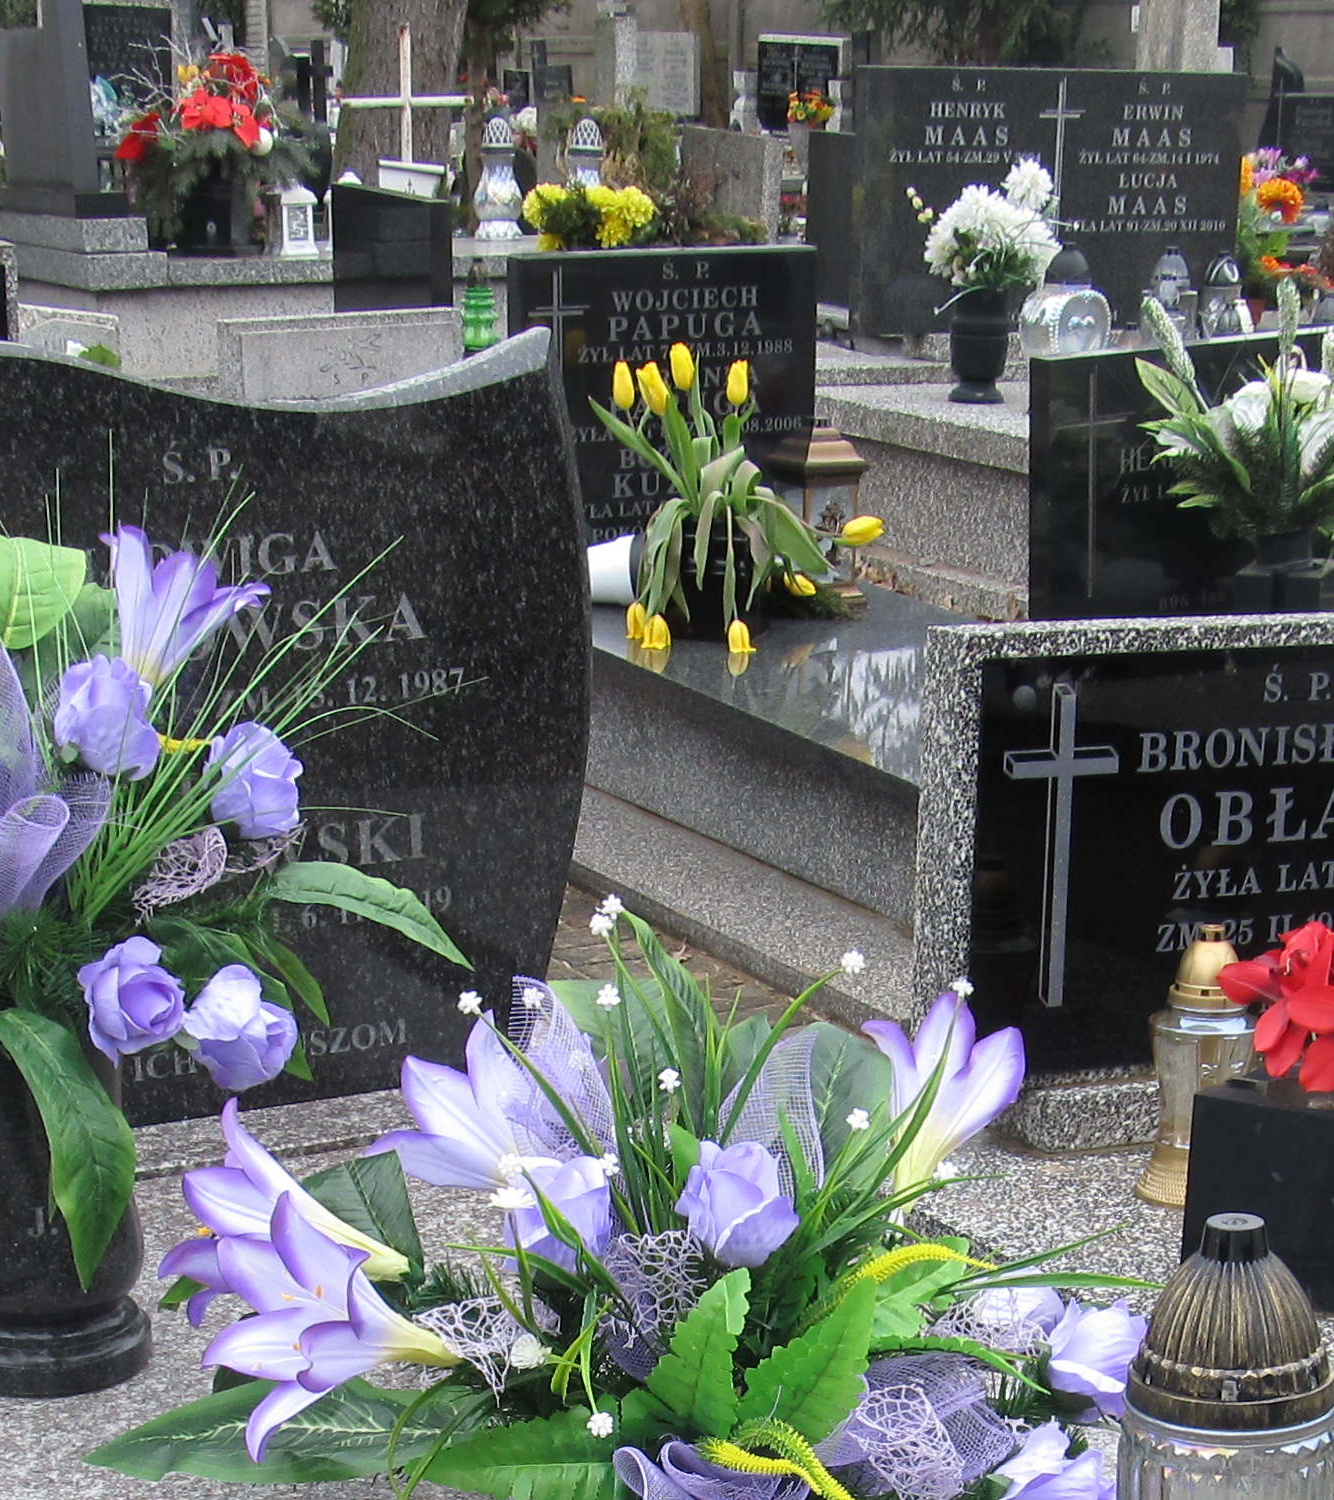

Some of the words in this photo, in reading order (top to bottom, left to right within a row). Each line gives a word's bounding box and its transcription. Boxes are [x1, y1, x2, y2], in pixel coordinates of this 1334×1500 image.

[929, 101, 1007, 119] HENRYK
[1122, 103, 1186, 121] ERWIN
[923, 124, 1010, 147] MAAS
[1111, 127, 1193, 148] MAAS
[888, 148, 916, 164] ŻYŁ
[917, 150, 944, 164] LAT
[1078, 149, 1105, 165] ŻYŁ
[1105, 151, 1131, 165] LAT
[1118, 172, 1180, 190] ŁUCJA
[1106, 195, 1188, 216] MAAS
[1099, 219, 1124, 232] LAT
[662, 258, 680, 280] Ś.
[695, 260, 710, 279] P.
[610, 285, 759, 313] WOJCIECH
[607, 311, 763, 342] PAPUGA
[577, 344, 613, 364] ŻYŁ
[618, 345, 656, 362] LAT
[162, 440, 196, 485] Ś.
[207, 447, 238, 481] P.
[618, 500, 656, 517] LAT
[399, 667, 465, 701] 1987
[1263, 664, 1289, 702] Ś.
[1309, 671, 1332, 701] P.
[281, 812, 428, 869] SKI
[1171, 863, 1263, 902] ŻYŁA
[301, 1017, 409, 1057] SZOM
